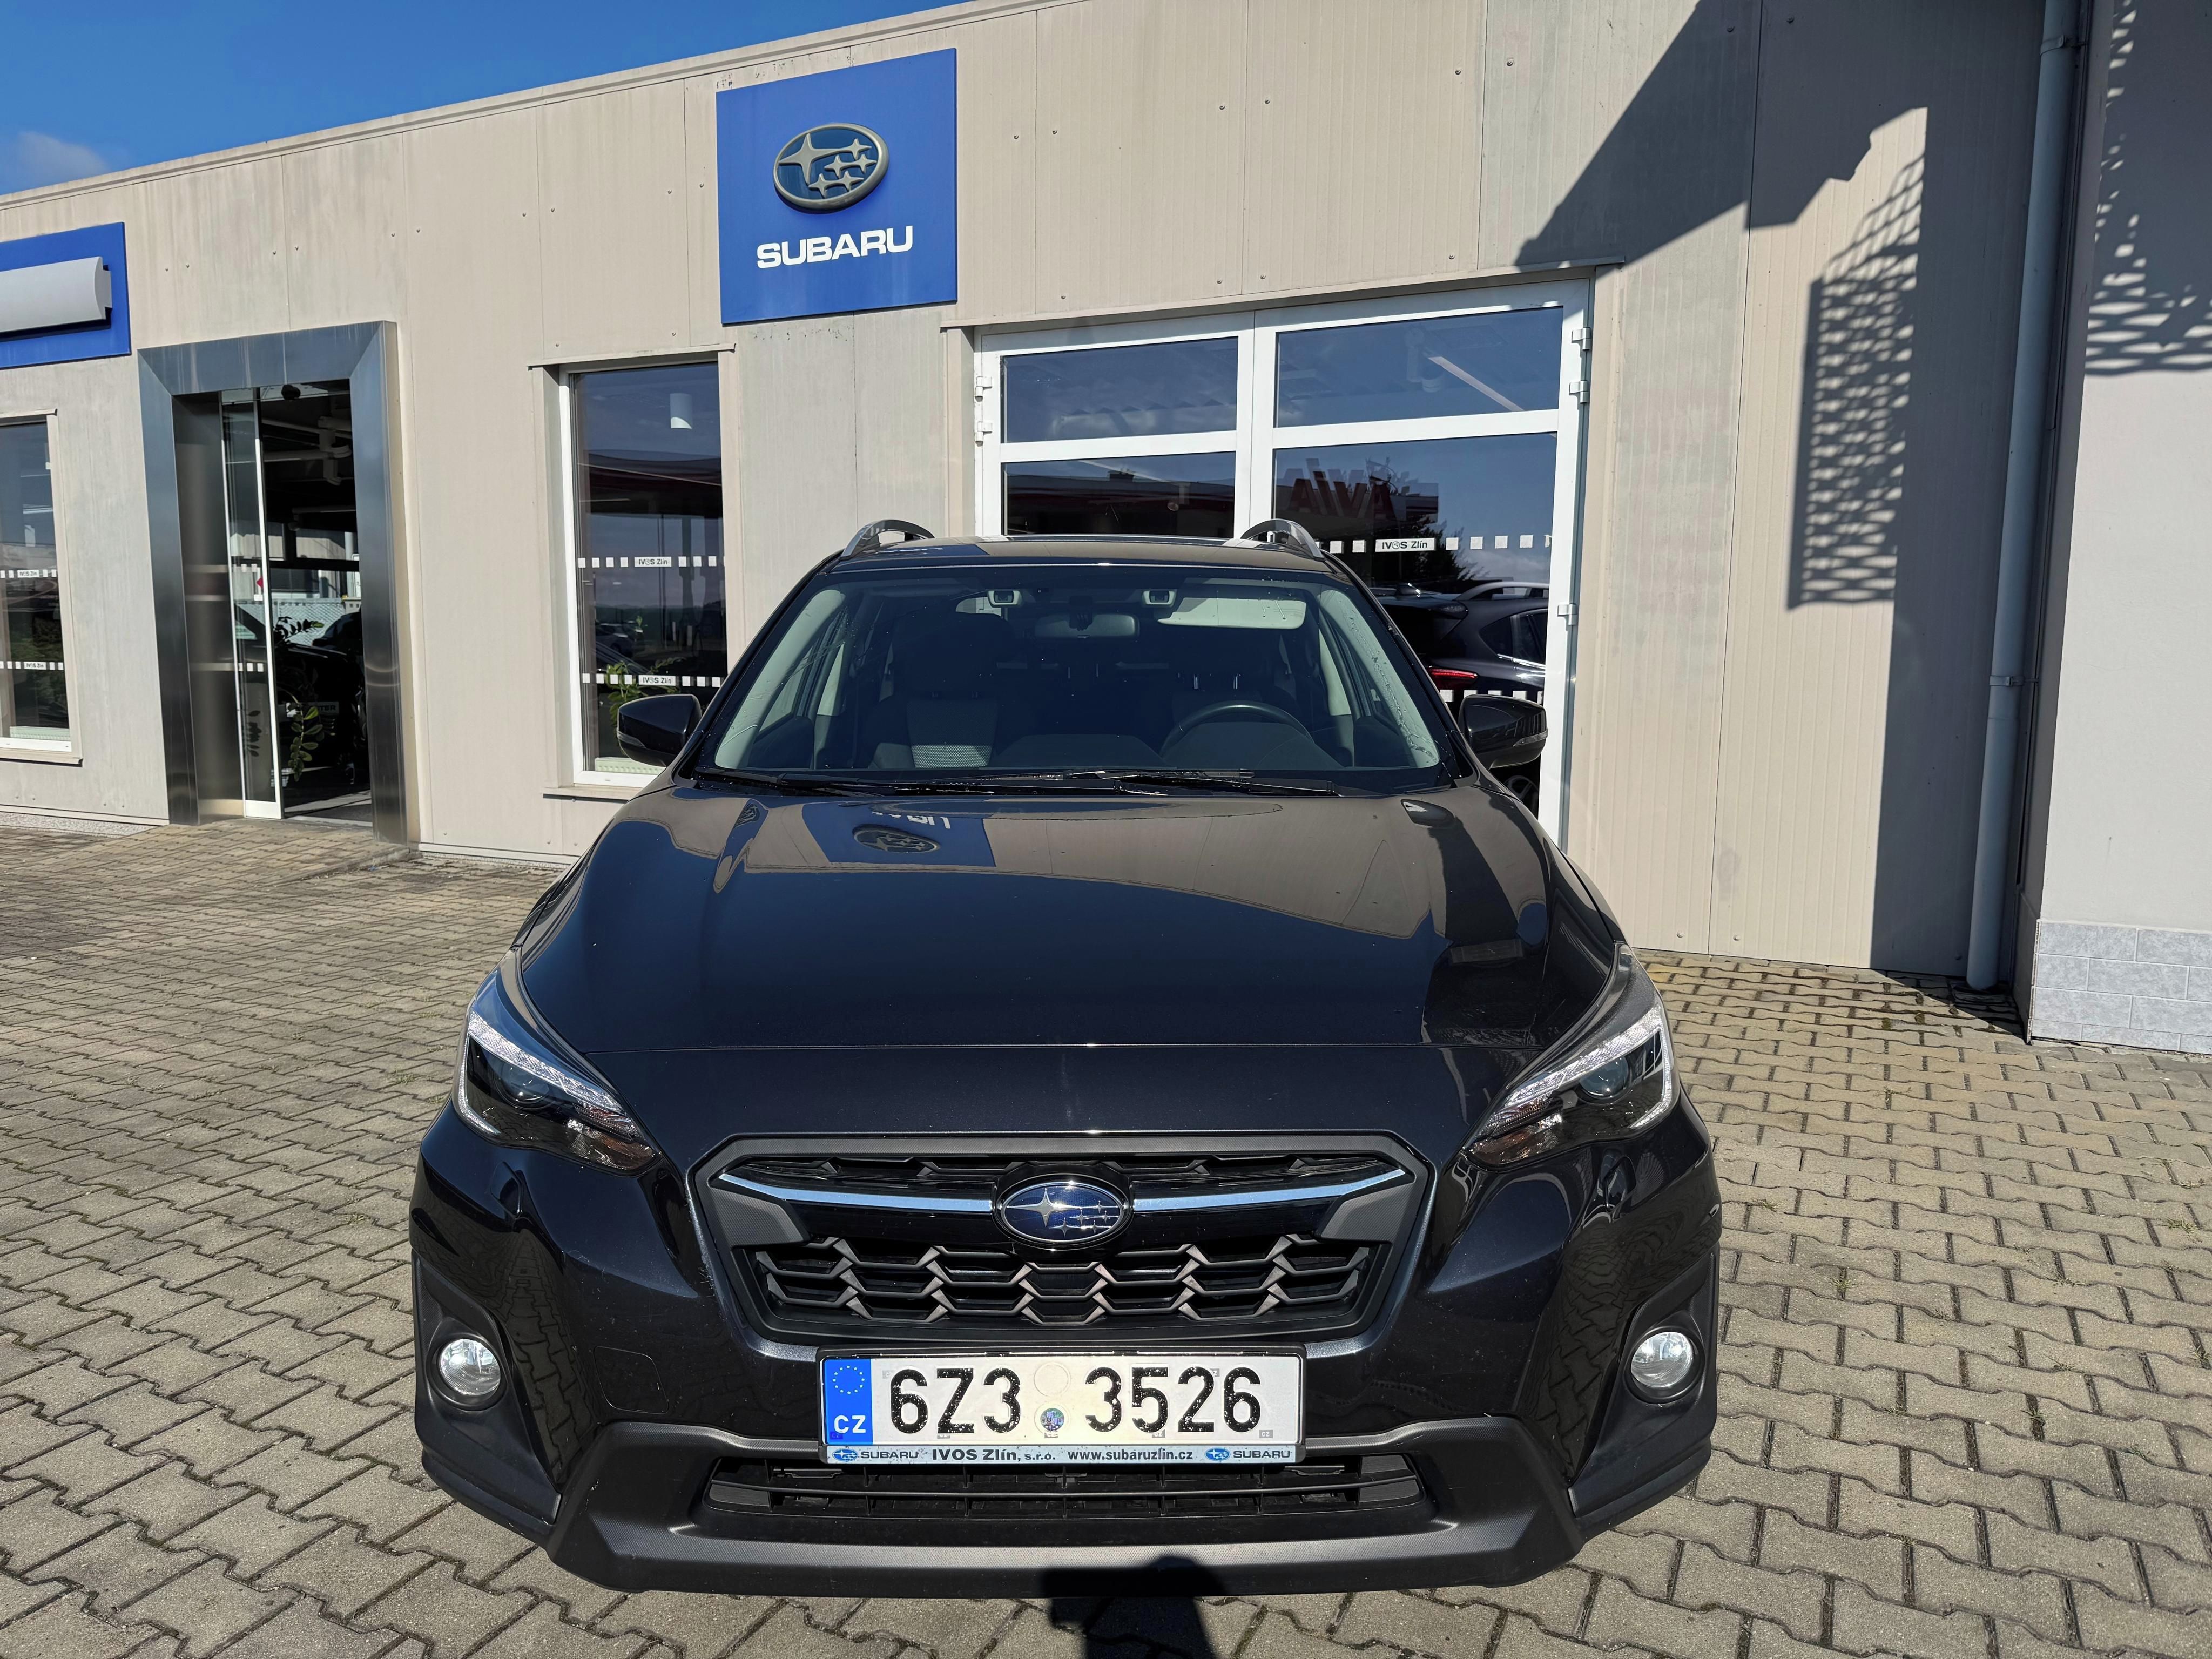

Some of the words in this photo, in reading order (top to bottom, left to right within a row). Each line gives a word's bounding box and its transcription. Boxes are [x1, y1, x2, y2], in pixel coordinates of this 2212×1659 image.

[757, 225, 913, 269] SUBARU
[1382, 541, 1408, 550] IVOS
[1411, 541, 1427, 549] Zlín
[891, 1368, 1021, 1434] 6Z3
[1085, 1366, 1260, 1433] 3526
[834, 1415, 866, 1434] CZ
[932, 1449, 977, 1460] IVOS
[982, 1449, 1021, 1462] Zlín,
[1068, 1448, 1193, 1460] www.subaruzlin.cz
